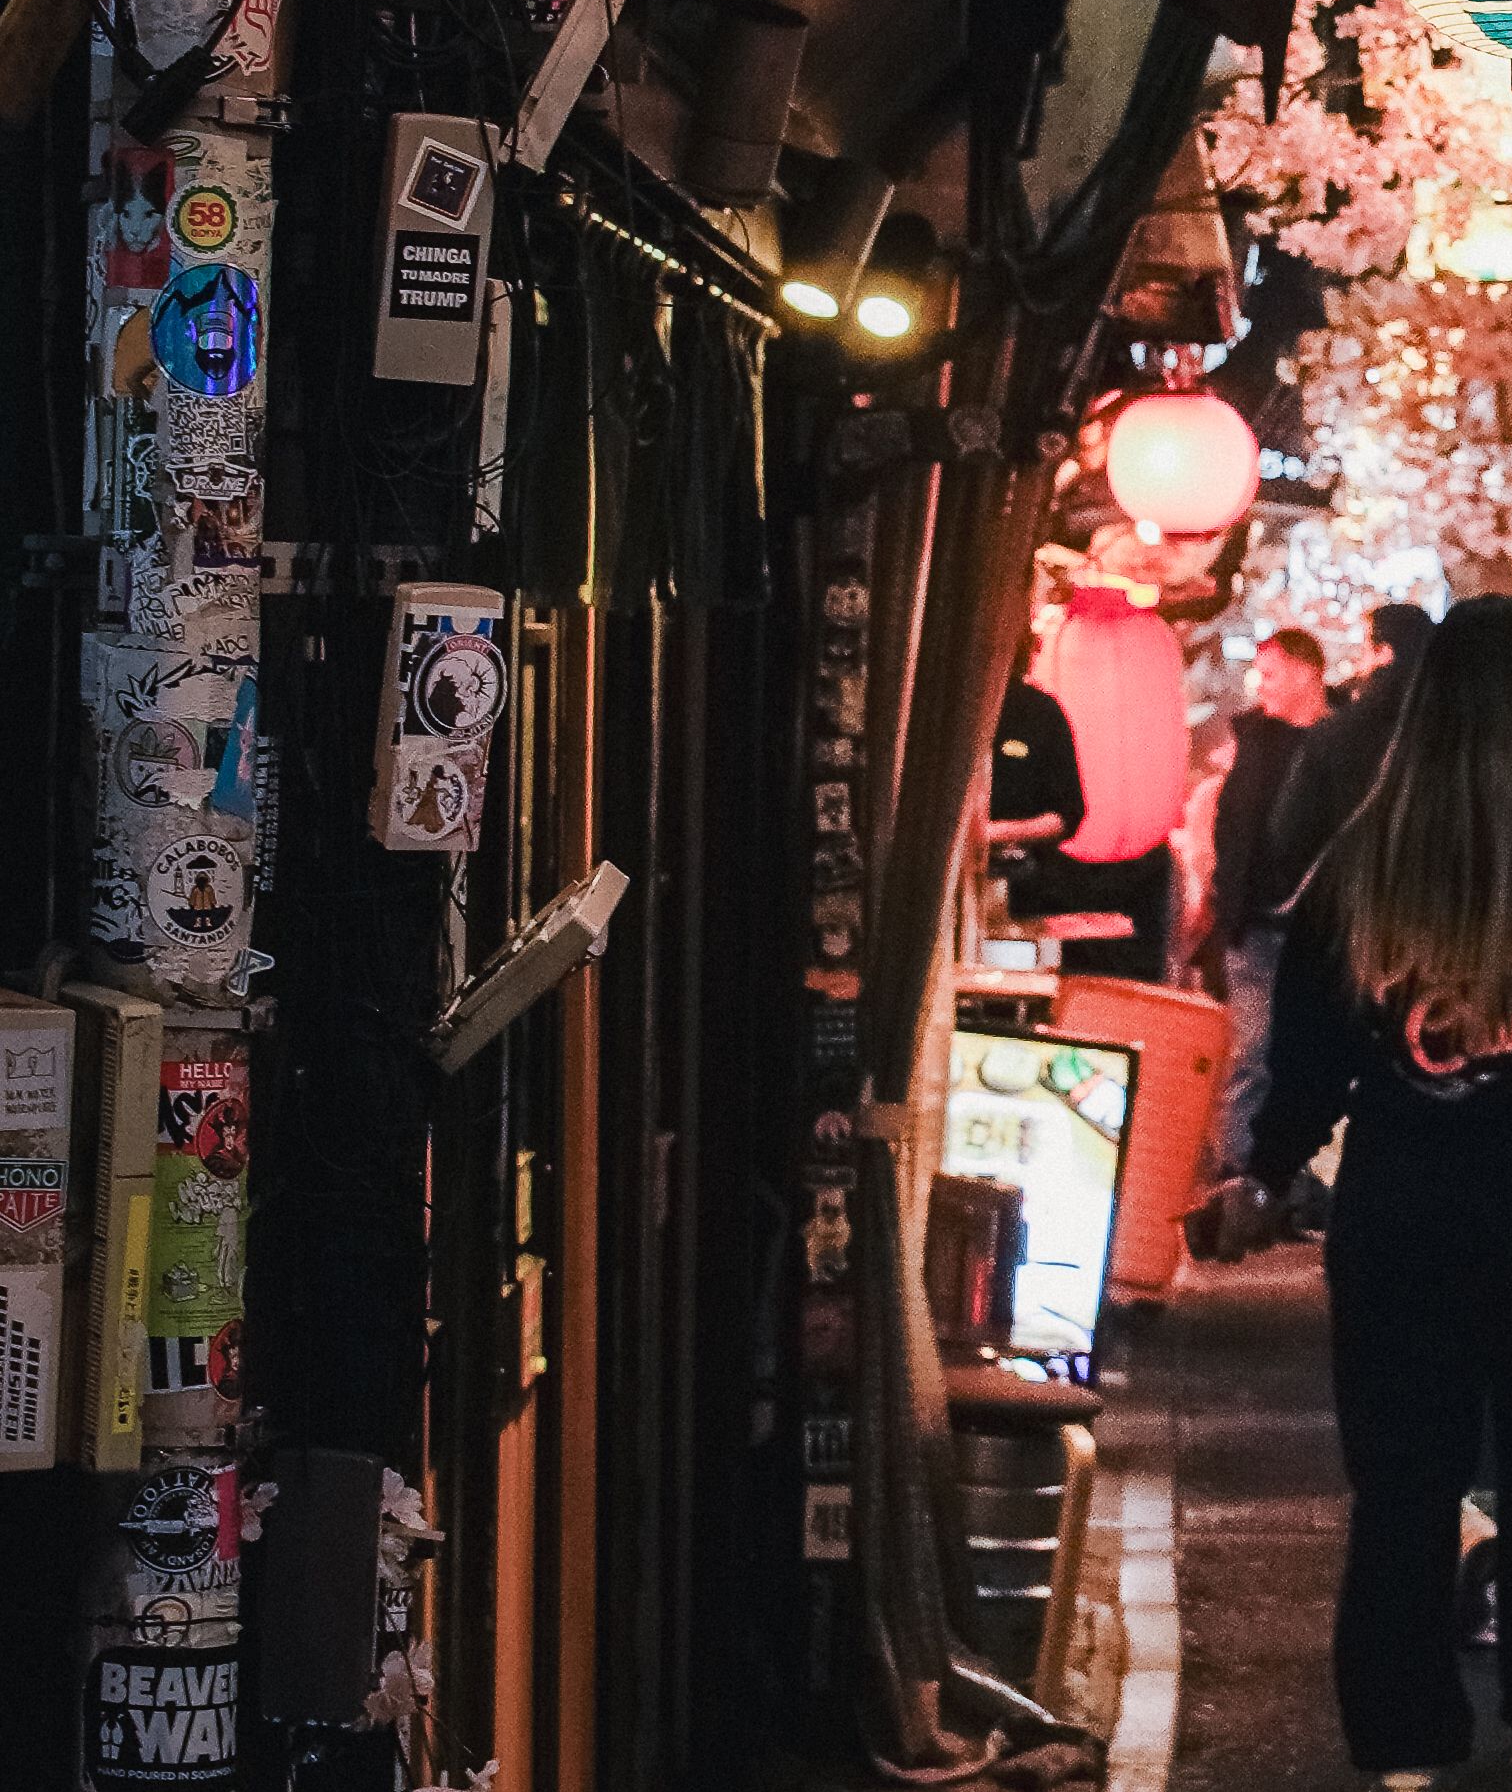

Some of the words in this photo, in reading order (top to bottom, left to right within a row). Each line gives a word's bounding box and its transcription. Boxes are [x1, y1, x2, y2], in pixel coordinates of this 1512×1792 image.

[187, 202, 226, 228] 58
[402, 245, 473, 265] CHINGA
[400, 269, 418, 281] TU
[418, 270, 471, 285] MADRE
[399, 289, 469, 309] TRUMP
[162, 920, 238, 947] SANTANDER
[179, 1062, 233, 1080] HELLO
[128, 1768, 176, 1781] POURED
[178, 1769, 190, 1781] IN
